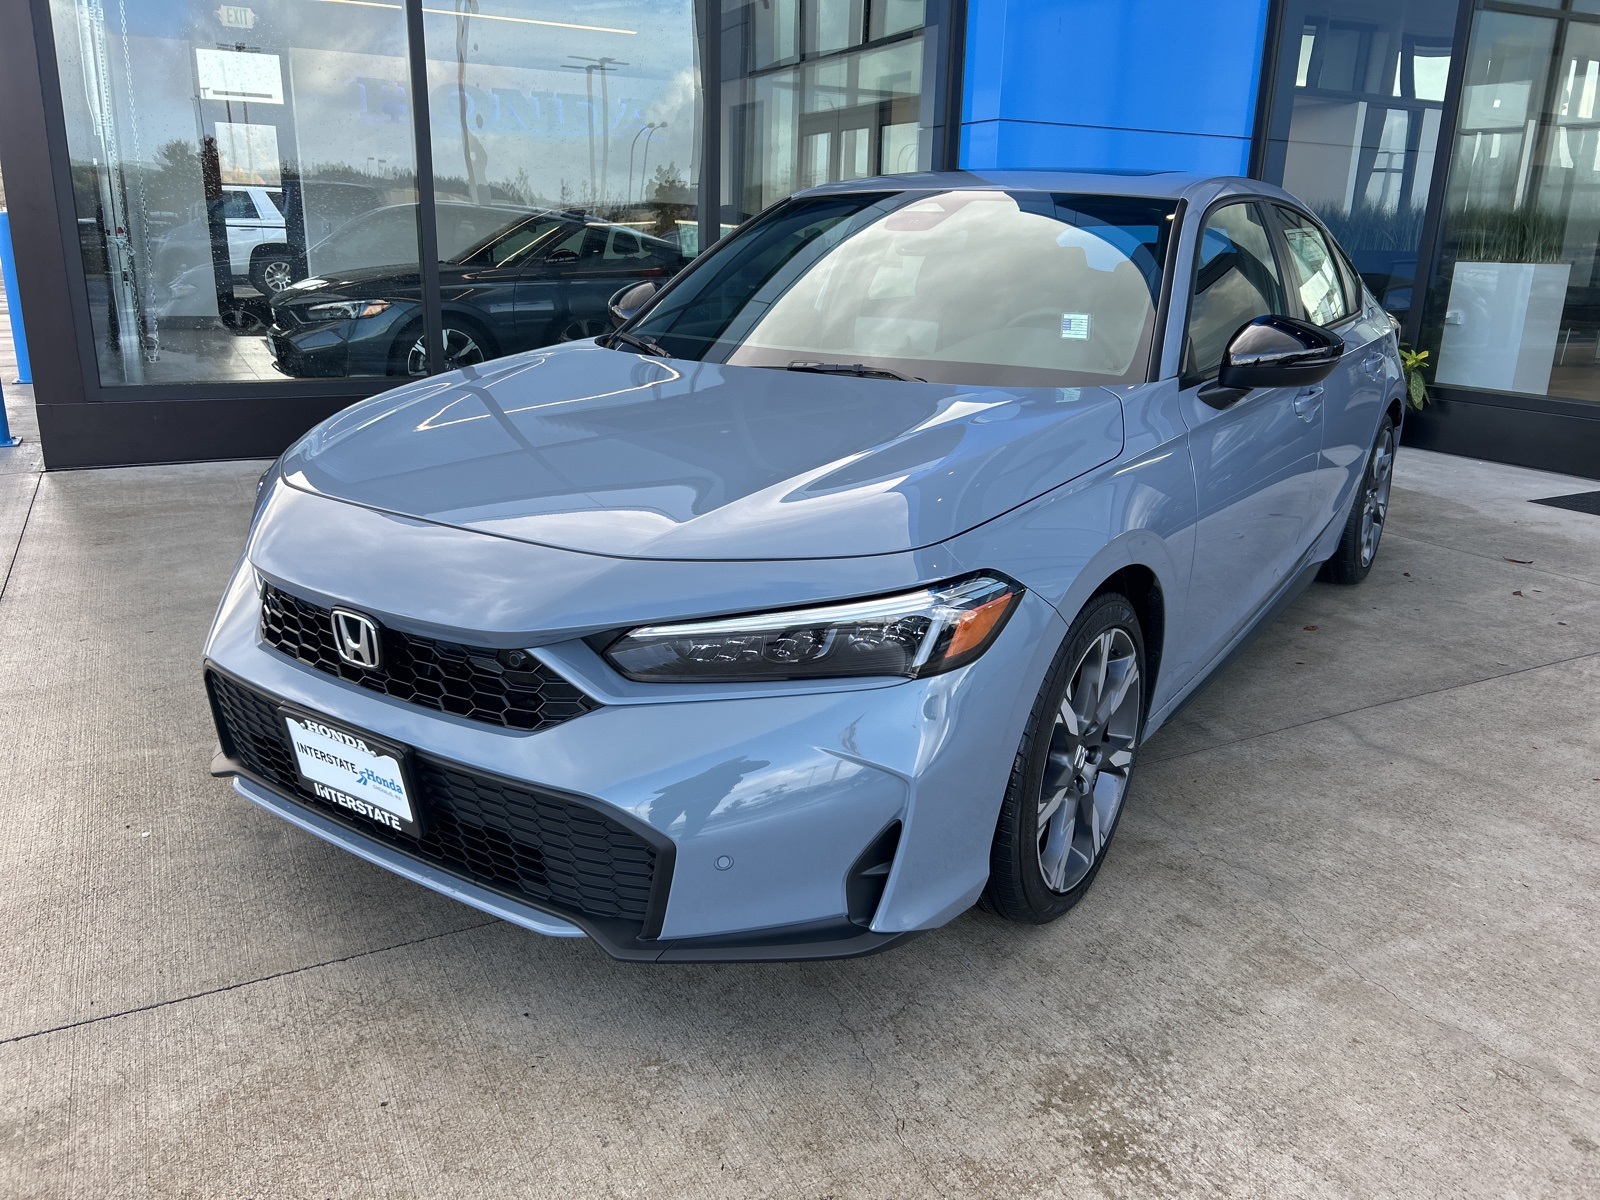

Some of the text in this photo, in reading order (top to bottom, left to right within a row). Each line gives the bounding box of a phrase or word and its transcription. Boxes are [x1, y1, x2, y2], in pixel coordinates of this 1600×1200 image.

[226, 7, 248, 25] EXIT
[304, 719, 371, 754] HONDA
[297, 742, 358, 774] INTERSTATE
[364, 768, 403, 794] Honda
[314, 782, 402, 831] INTERSTATE
